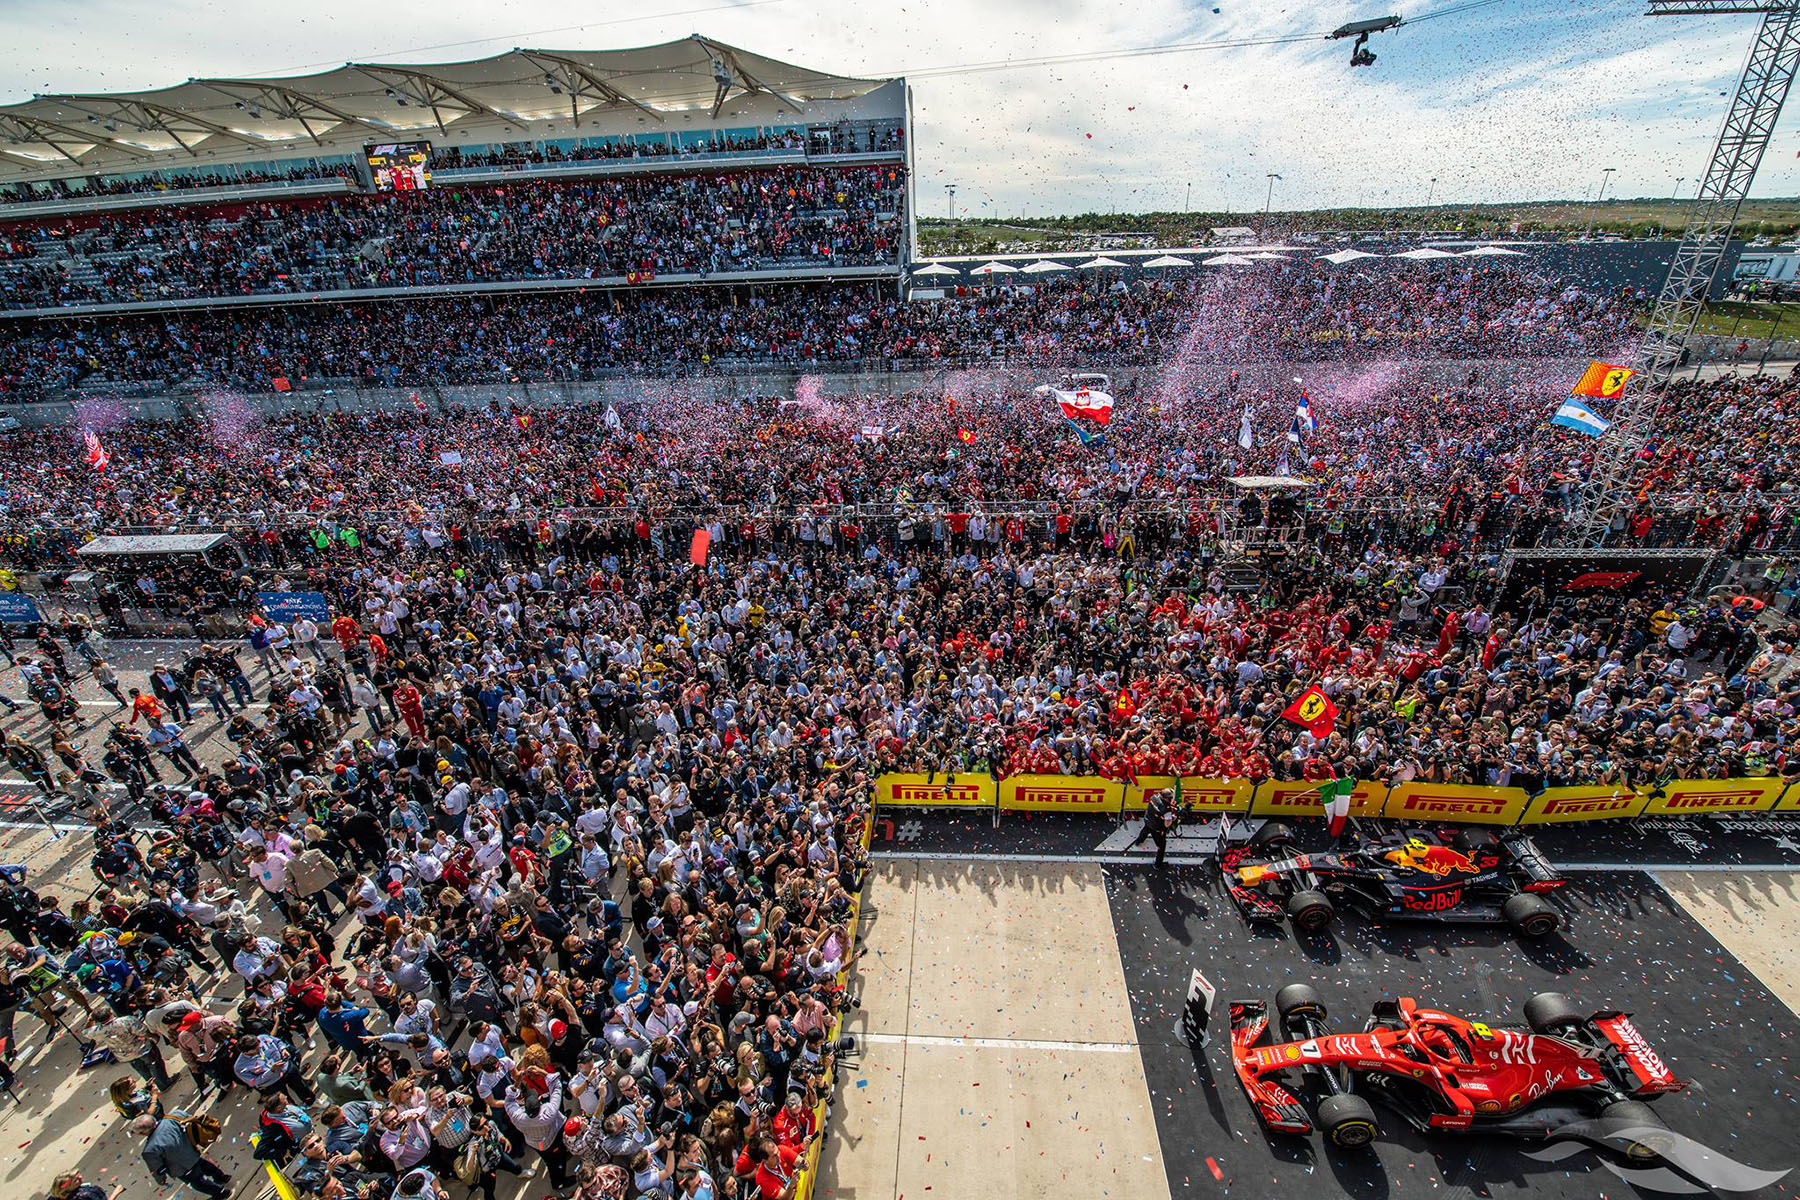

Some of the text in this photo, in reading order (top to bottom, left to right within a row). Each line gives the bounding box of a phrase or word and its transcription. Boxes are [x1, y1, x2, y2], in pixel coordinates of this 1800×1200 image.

[892, 784, 981, 801] PIRELLI
[1015, 786, 1107, 804] PIRELLI
[1665, 789, 1766, 809] PIRELLI
[1403, 793, 1508, 815] PIRELLI
[1541, 793, 1637, 815] PIRELLI
[1480, 856, 1499, 868] 33
[1621, 1019, 1669, 1077] MISSION
[1324, 1066, 1338, 1089] Lenovo
